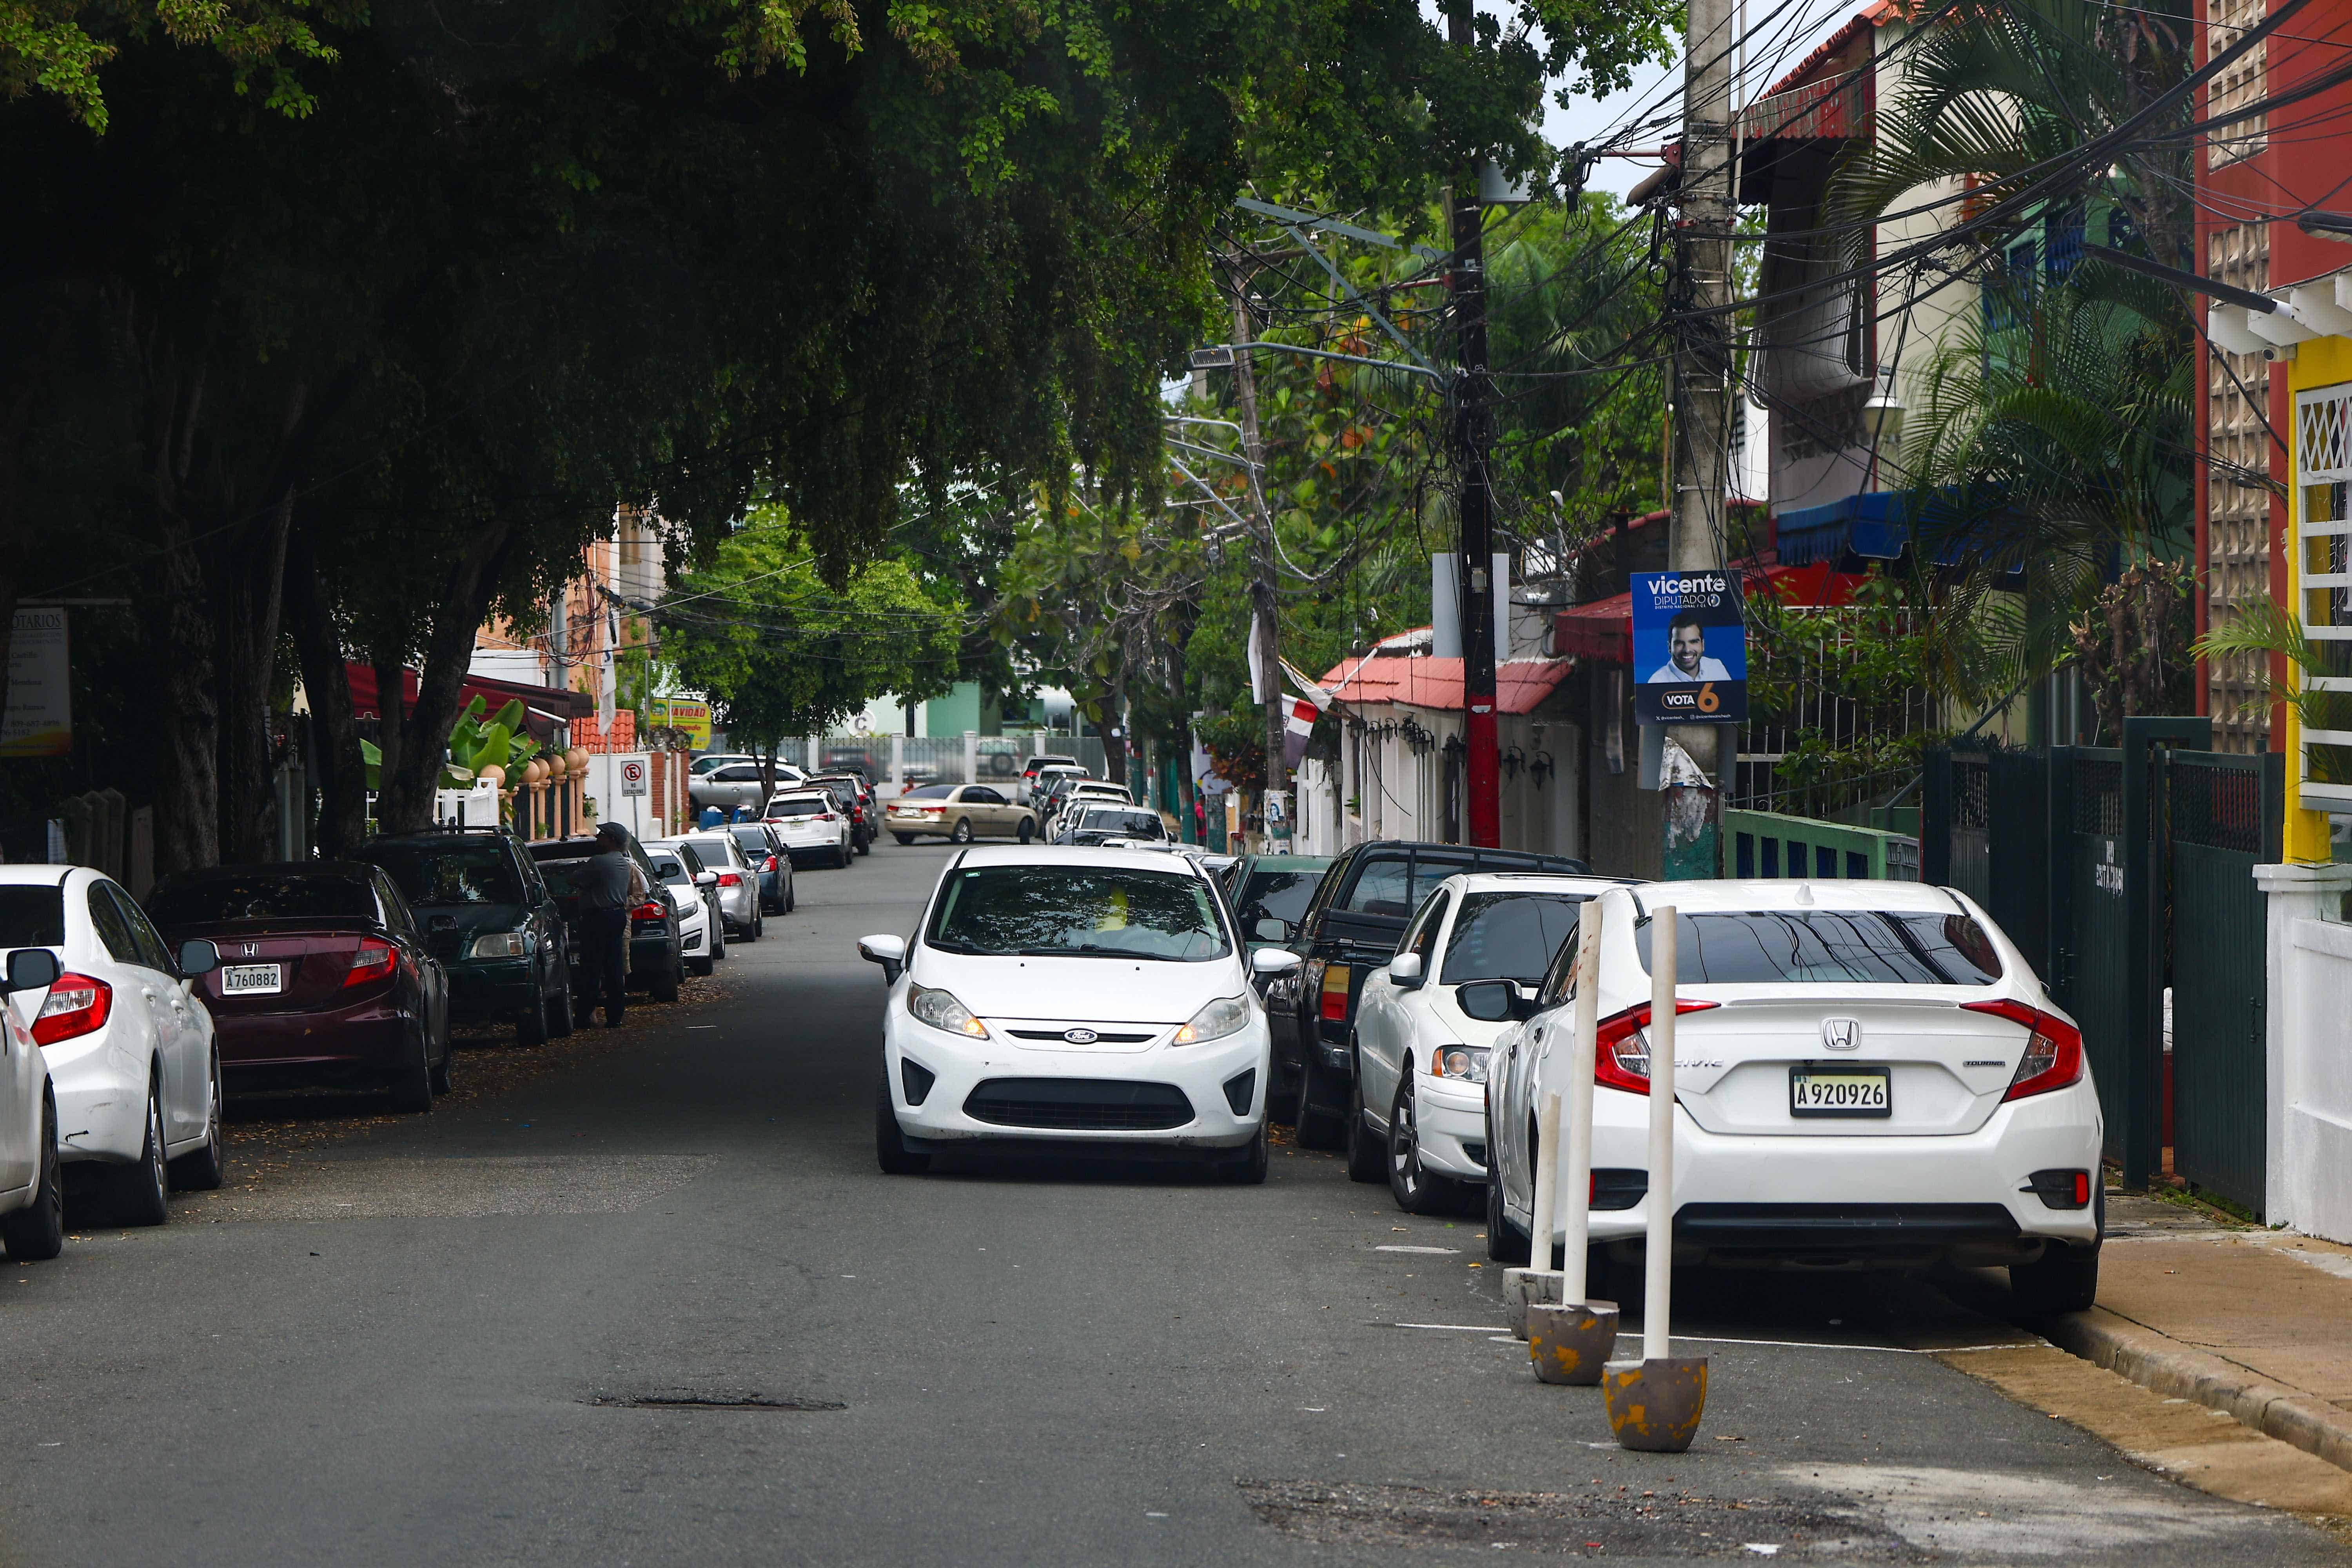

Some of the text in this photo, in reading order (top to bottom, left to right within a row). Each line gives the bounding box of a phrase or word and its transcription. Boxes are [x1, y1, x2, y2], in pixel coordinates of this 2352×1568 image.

[1648, 573, 1726, 594] vicente
[1655, 595, 1706, 605] DIPUTADO
[12, 614, 60, 628] OTARIOS
[1667, 682, 1719, 713] VOTA 6
[2107, 840, 2114, 863] NO
[227, 973, 276, 987] A760882
[1798, 1083, 1883, 1104] A920926
